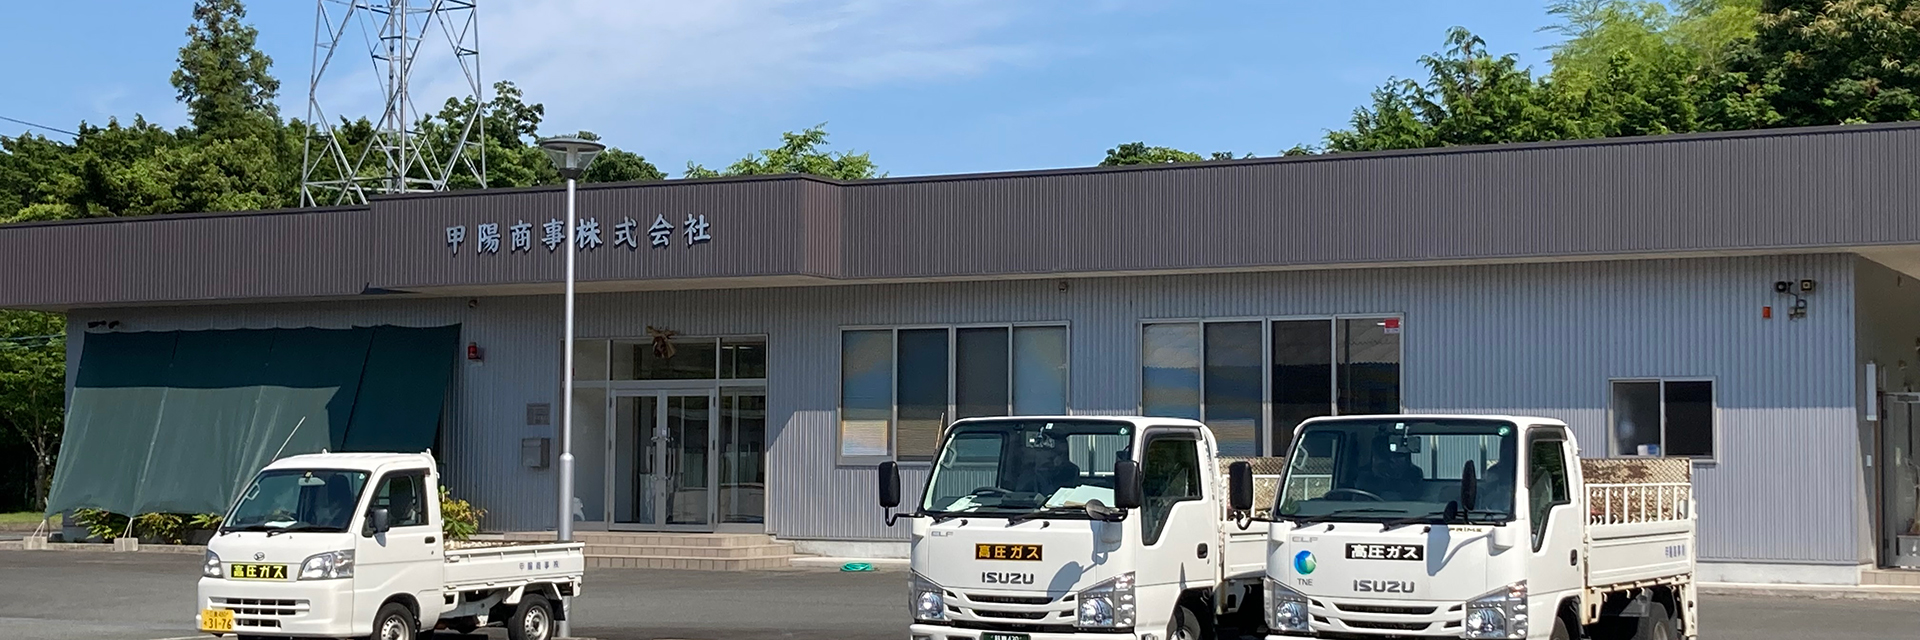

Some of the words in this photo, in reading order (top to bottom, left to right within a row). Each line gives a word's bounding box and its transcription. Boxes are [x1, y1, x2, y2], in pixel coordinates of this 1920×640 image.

[446, 213, 712, 254] 甲陽商事株式会社
[978, 545, 1039, 559] 高圧ガス
[1351, 544, 1419, 559] 高圧ガス
[233, 565, 284, 578] 高圧ガス
[981, 572, 1034, 584] ISUZU
[1297, 578, 1313, 586] TNE
[1353, 580, 1415, 593] ISUZU
